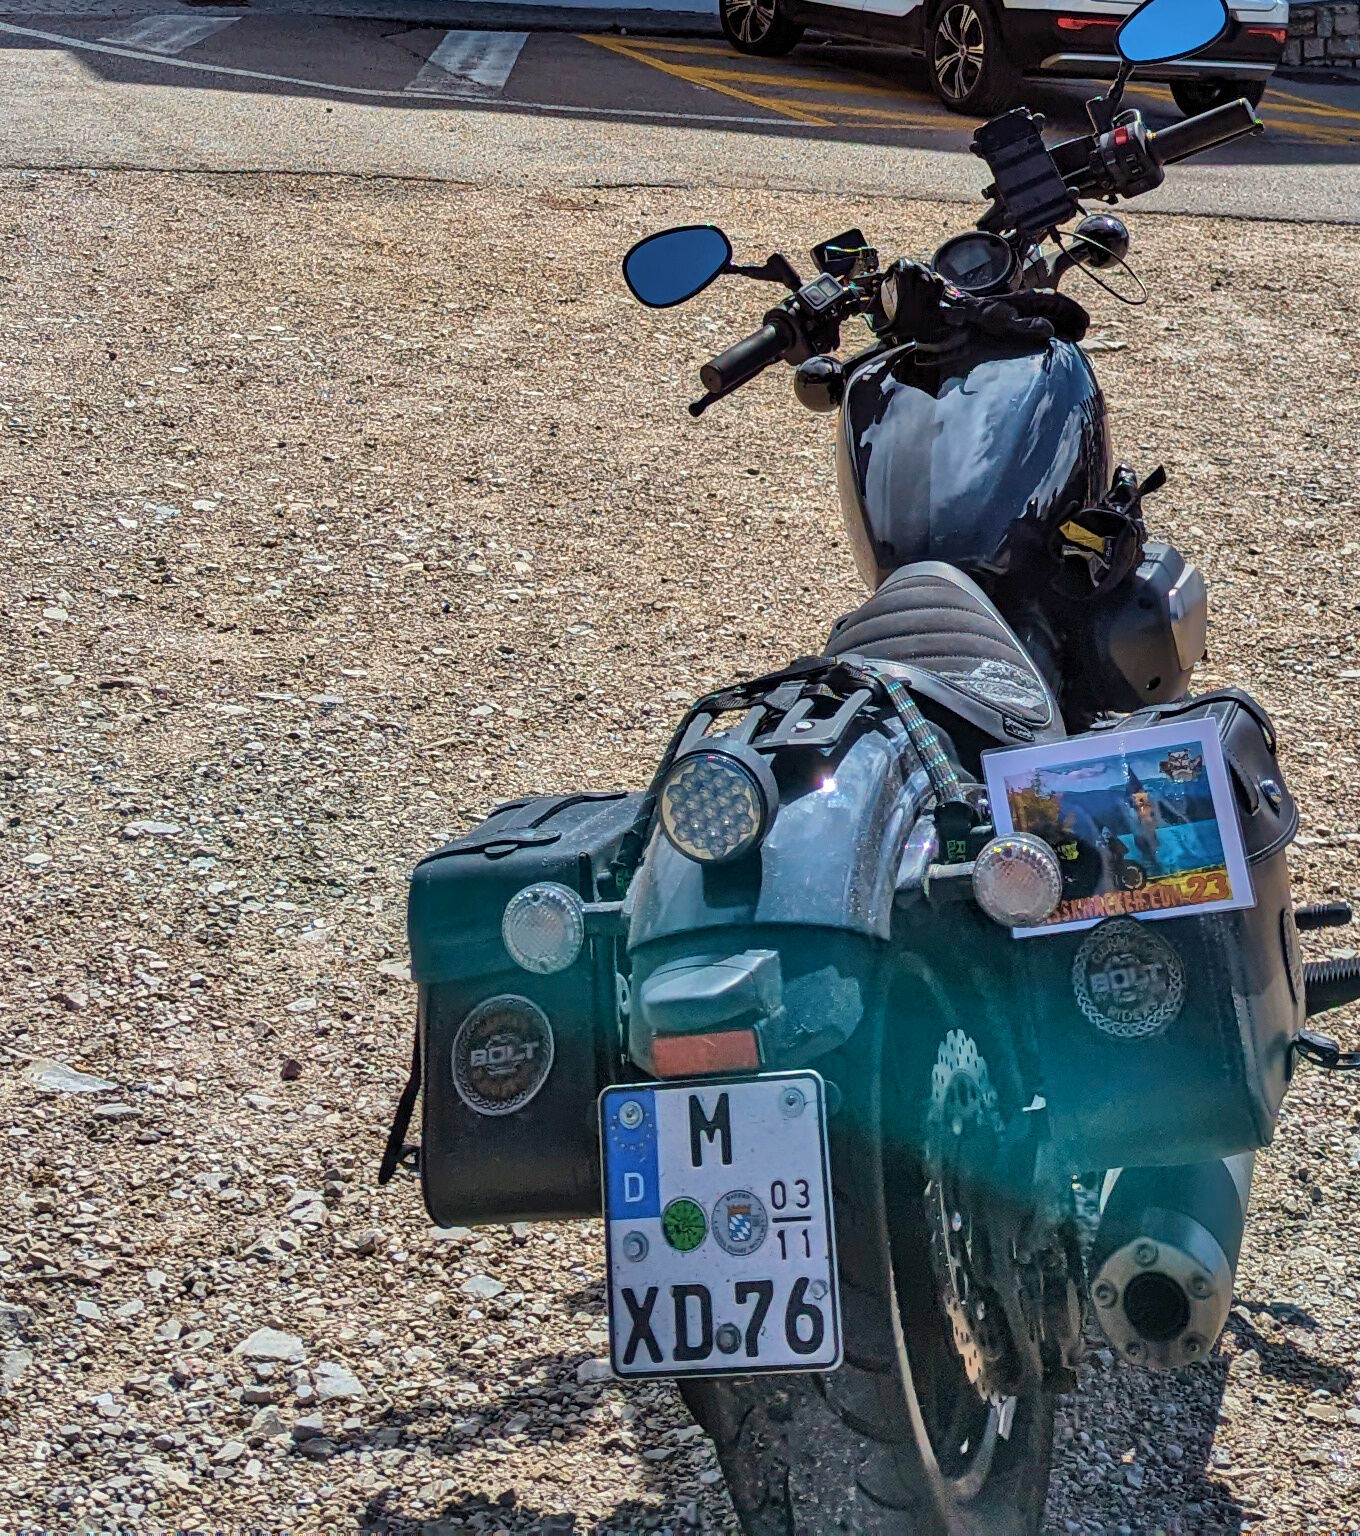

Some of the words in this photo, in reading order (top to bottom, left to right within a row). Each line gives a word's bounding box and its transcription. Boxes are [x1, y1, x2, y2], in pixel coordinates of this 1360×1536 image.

[1186, 871, 1231, 905] 23
[470, 1040, 540, 1067] BOLT
[689, 1092, 733, 1168] M
[624, 1172, 645, 1203] D
[770, 1178, 811, 1211] 03
[776, 1228, 812, 1261] 11
